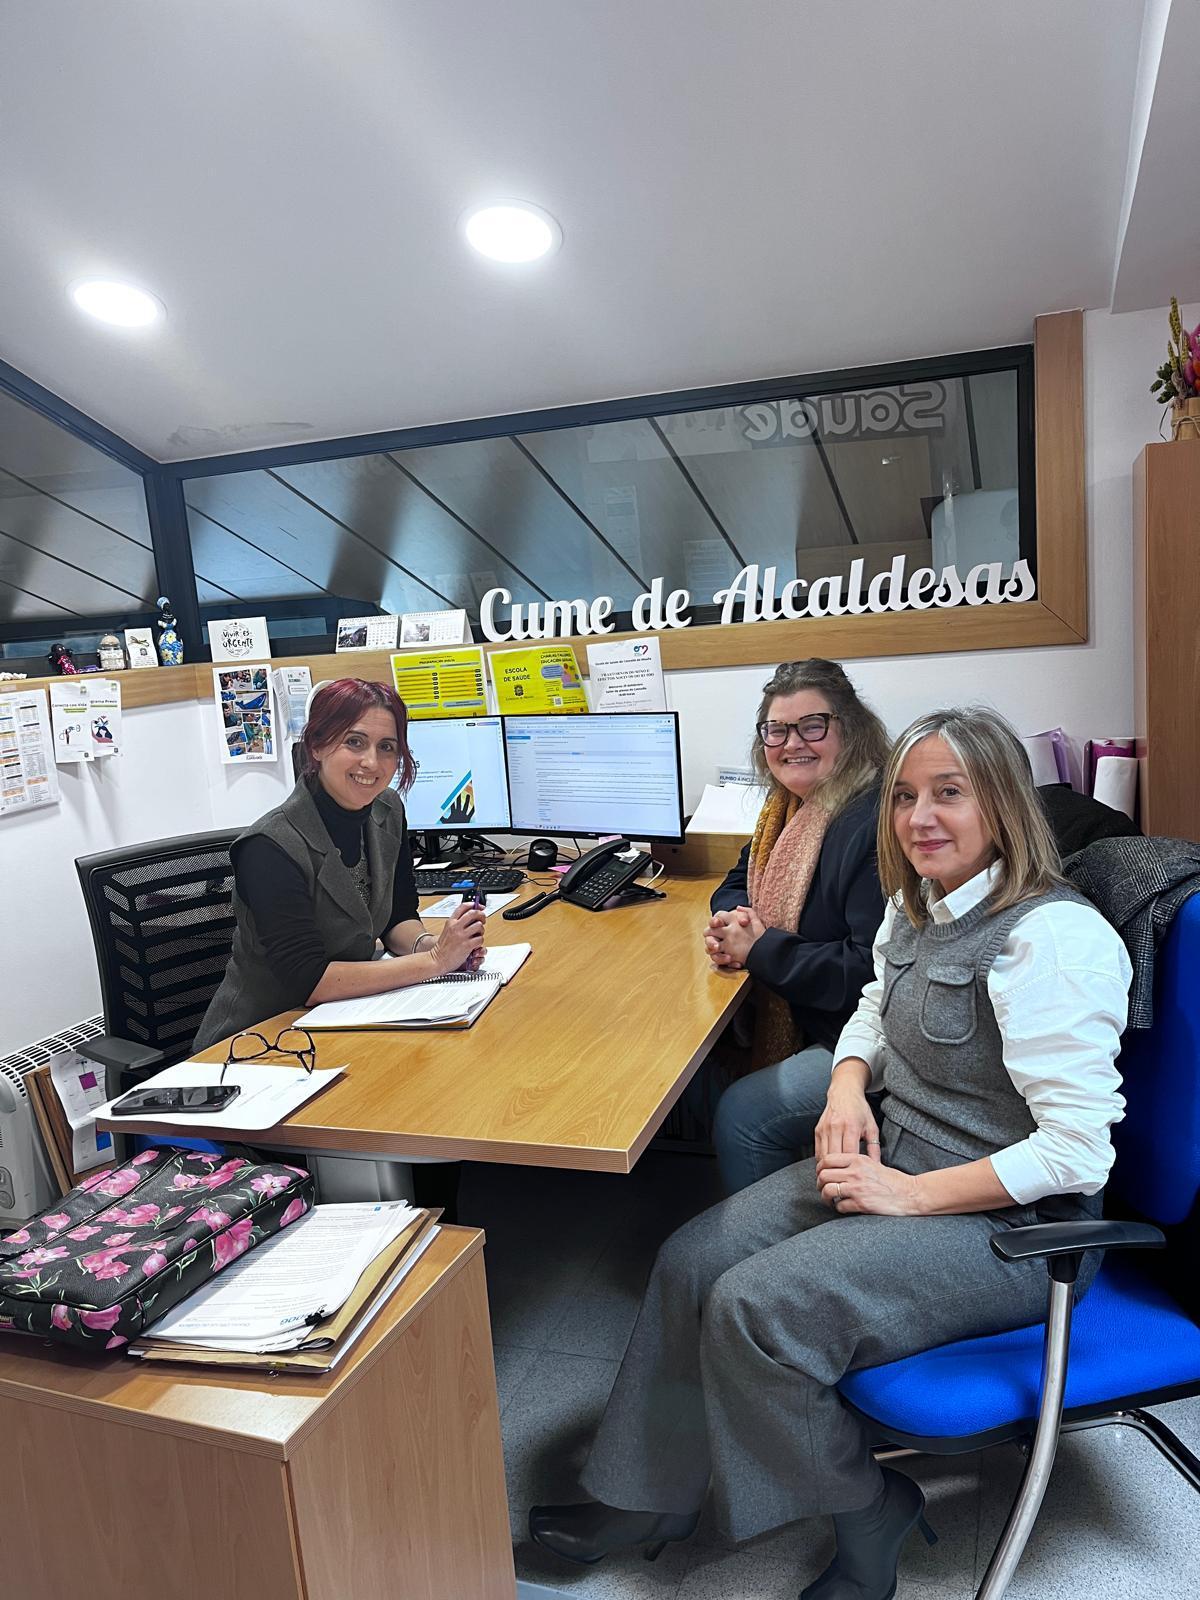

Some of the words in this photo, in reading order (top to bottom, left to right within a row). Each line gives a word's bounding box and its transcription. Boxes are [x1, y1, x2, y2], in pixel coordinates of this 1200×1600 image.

[480, 587, 616, 642] Cume
[632, 577, 693, 630] de
[712, 555, 1037, 625] Alcaldesas
[222, 638, 254, 648] URGENTE
